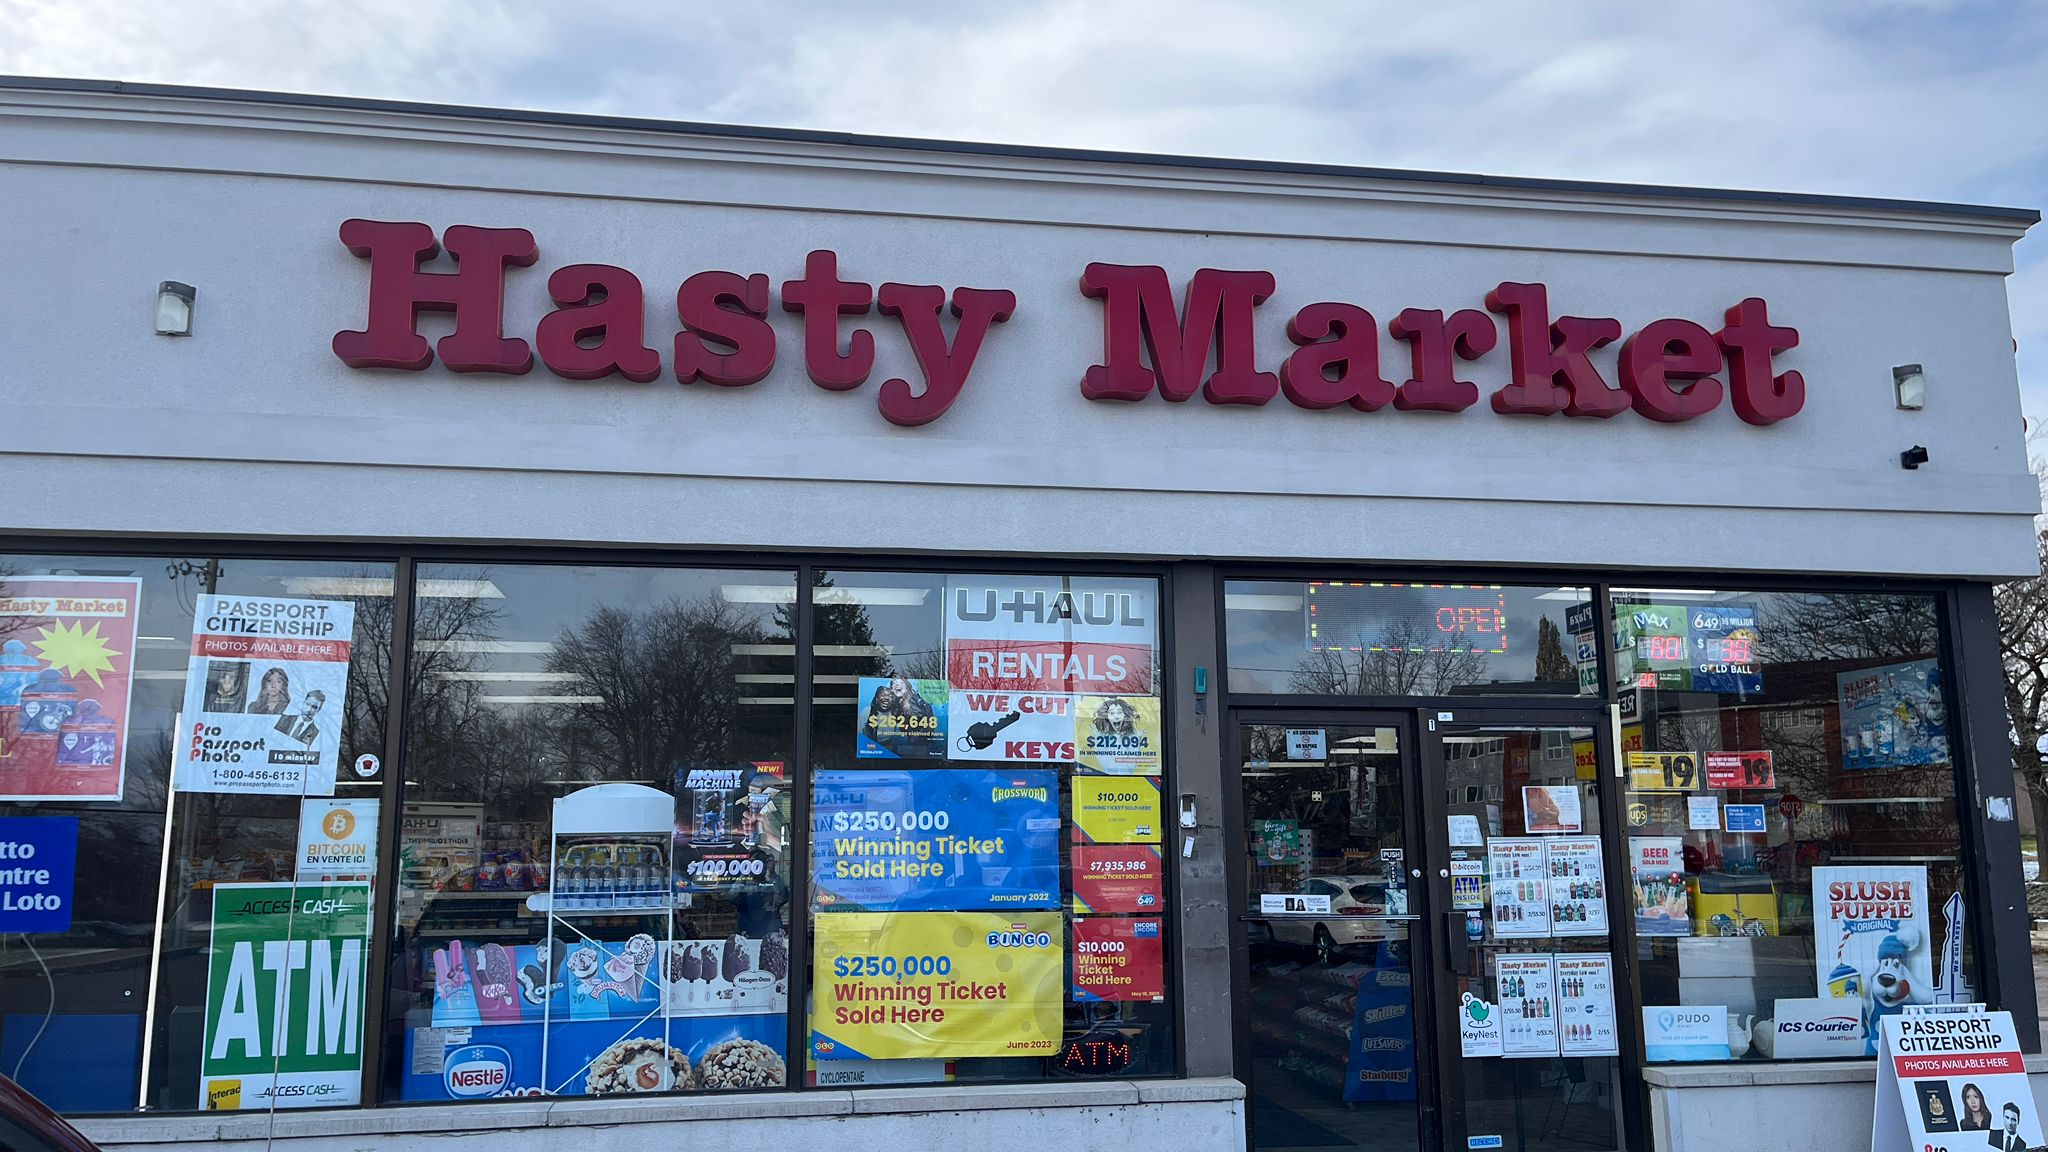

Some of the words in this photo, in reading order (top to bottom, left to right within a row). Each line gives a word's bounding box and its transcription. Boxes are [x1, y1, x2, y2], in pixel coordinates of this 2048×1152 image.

[331, 218, 1017, 427] Hasty
[1079, 262, 1806, 426] Market
[56, 600, 124, 612] Market
[216, 600, 329, 620] PASSPORT
[206, 616, 335, 637] CITIZENSHIP
[1633, 611, 1668, 629] MAX
[205, 640, 248, 651] PHOTOS
[250, 642, 304, 654] AVAILABLE
[306, 645, 333, 655] HERE
[972, 651, 1128, 682] RENTALS
[1731, 664, 1753, 674] BALL
[966, 694, 1010, 713] WE
[1018, 696, 1070, 715] CUT
[193, 722, 222, 736] Pro
[868, 714, 938, 730] $262,648
[191, 735, 266, 752] Passport
[1086, 736, 1149, 749] $212,094
[190, 748, 242, 763] Photo
[273, 753, 283, 761] 10
[1005, 741, 1075, 760] KEYS
[212, 769, 300, 781] 1-800-456-6132
[687, 769, 743, 780] MONEY
[757, 765, 780, 773] NEW!
[1661, 755, 1695, 787] 19
[1741, 758, 1770, 785] 19
[685, 779, 742, 789] MACHINE
[992, 787, 1047, 803] CROSSWORD
[1097, 792, 1138, 803] $10,000
[834, 809, 950, 836] $250,000
[1629, 810, 1646, 824] ups
[308, 844, 366, 855] BITCOIN
[834, 835, 931, 861] Winning
[936, 835, 1004, 855] Ticket
[1643, 848, 1669, 857] BEER
[687, 859, 764, 876] $100,000
[836, 858, 888, 878] Sold
[891, 859, 944, 878] Here
[1090, 861, 1147, 872] $7,935,986
[1454, 877, 1480, 893] ATM
[1828, 881, 1912, 901] SLUSH
[3, 891, 61, 911] Loto
[990, 893, 1027, 904] January
[1029, 893, 1049, 902] 2022
[240, 900, 301, 914] ACCESS
[302, 899, 343, 914] CASH
[1857, 920, 1893, 932] ORIGINAL
[988, 933, 1049, 946] BINGO
[1078, 941, 1125, 954] $10,000
[834, 955, 951, 981] $250,000
[1078, 954, 1126, 967] Winning
[1560, 961, 1580, 969] Hasty
[1078, 965, 1114, 974] Ticket
[1078, 975, 1104, 985] Sold
[1105, 975, 1132, 984] Here
[590, 980, 626, 999] DRUMSTICK
[834, 981, 932, 1006] Winning
[937, 981, 1007, 1001] Ticket
[210, 937, 362, 1060] ATM
[835, 1005, 889, 1024] Sold
[892, 1005, 945, 1023] Here
[1677, 1014, 1710, 1023] PUDO
[1778, 1022, 1801, 1033] ICS
[1804, 1021, 1857, 1033] Courier
[1901, 1019, 1992, 1035] PASSPORT
[1462, 1030, 1498, 1041] KeyNest
[1006, 1040, 1028, 1049] June
[1030, 1040, 1052, 1048] 2023
[1899, 1035, 2002, 1052] CITIZENSHIP
[1064, 1042, 1130, 1068] ATM
[1905, 1061, 1940, 1070] PHOTOS
[1941, 1059, 1985, 1069] AVAILABLE
[1987, 1057, 2009, 1067] HERE
[820, 1071, 865, 1084] CYCLOPENTANE
[1361, 1070, 1408, 1081] Starburst
[209, 1085, 241, 1100] Interac
[263, 1085, 305, 1097] ACCESS
[307, 1084, 336, 1095] CASH
